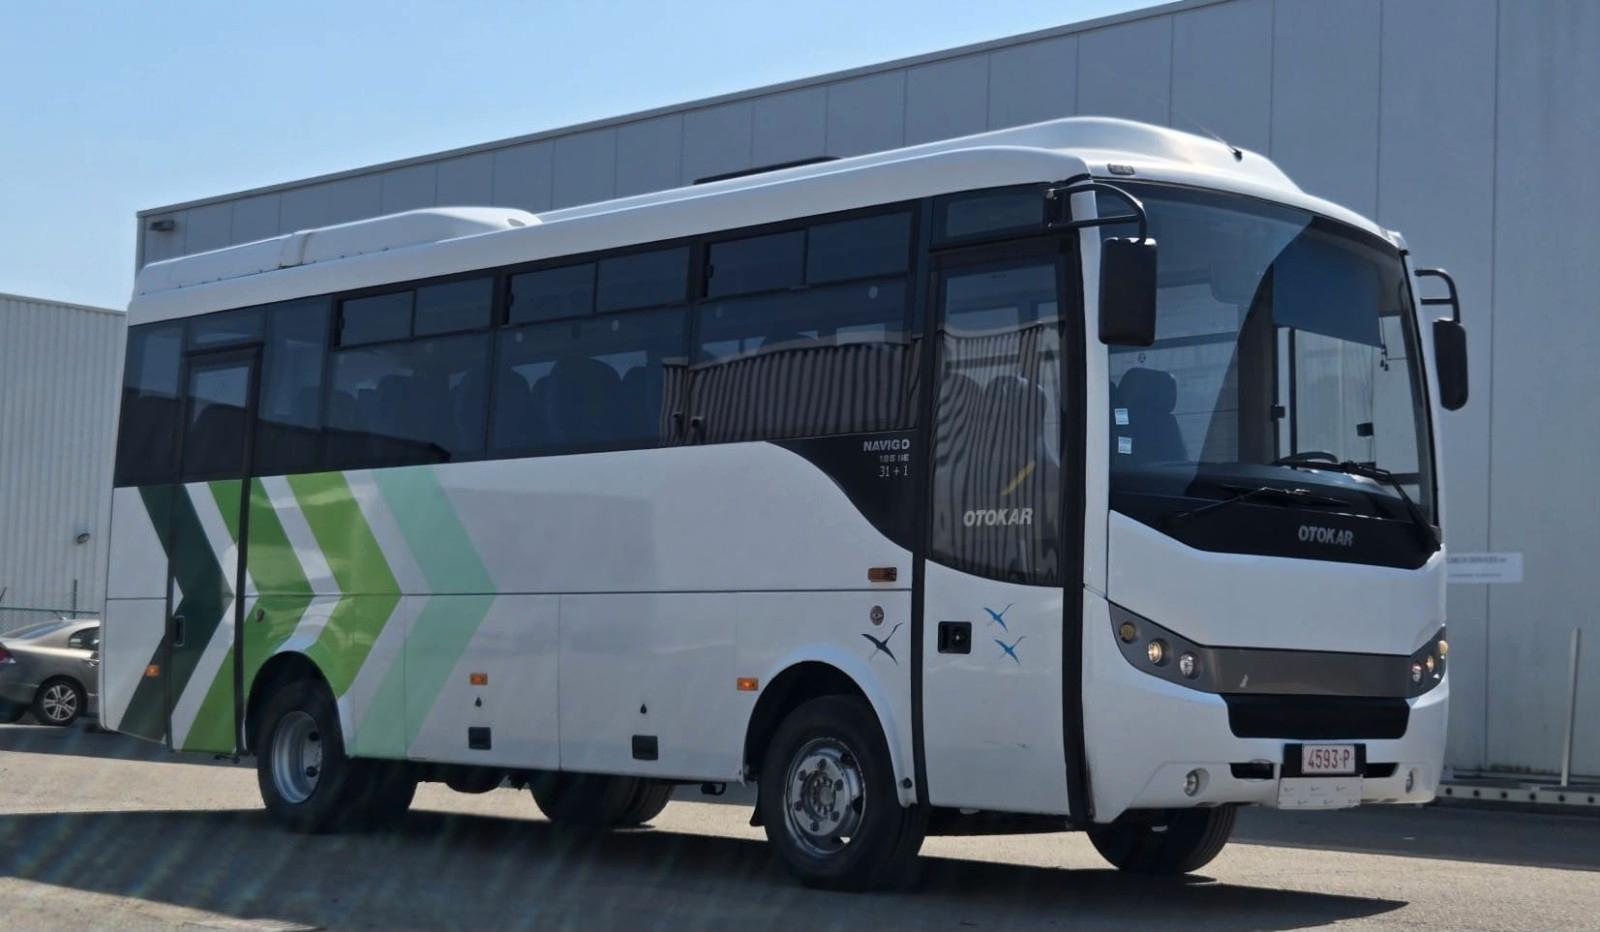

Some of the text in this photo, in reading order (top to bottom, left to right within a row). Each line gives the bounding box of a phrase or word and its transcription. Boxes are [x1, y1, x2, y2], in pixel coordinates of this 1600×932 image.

[863, 438, 910, 452] NAVIGO
[879, 465, 890, 478] 31
[963, 507, 1033, 528] OTOKAR
[1298, 525, 1354, 548] OTOKAR
[1307, 748, 1350, 769] 4593-P
